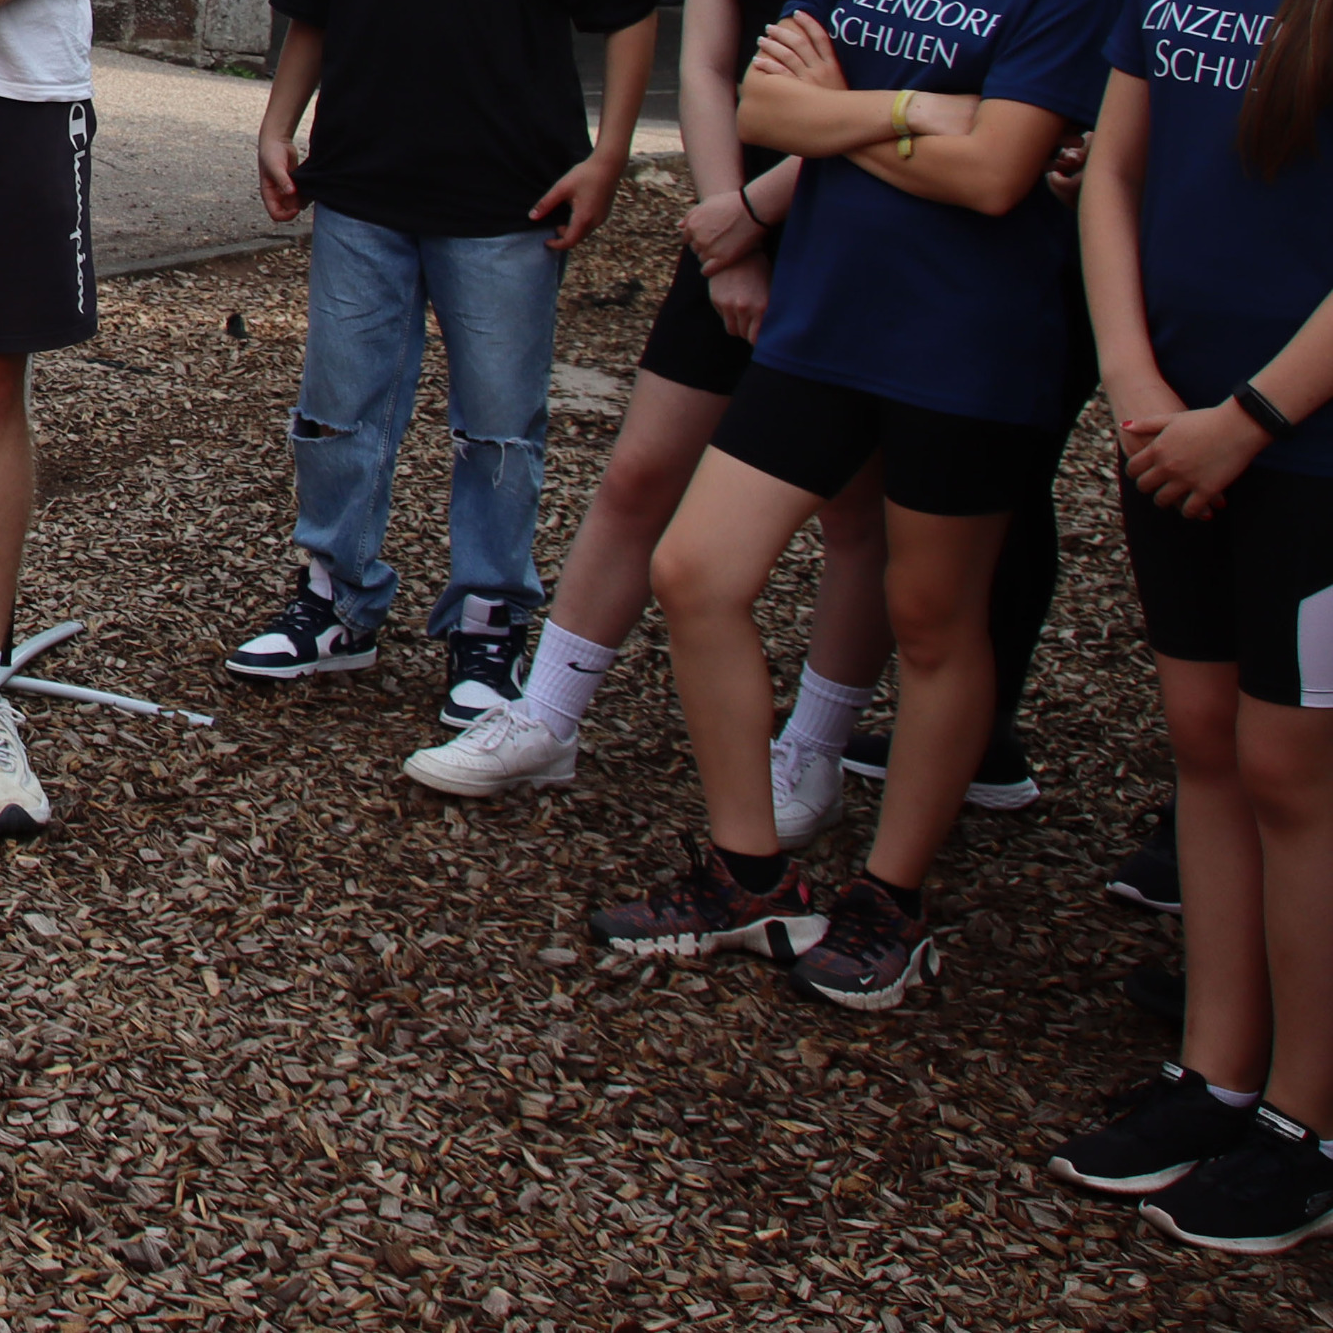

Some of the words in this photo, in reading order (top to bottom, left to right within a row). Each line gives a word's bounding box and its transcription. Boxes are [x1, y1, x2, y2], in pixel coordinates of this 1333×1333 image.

[829, 7, 959, 69] SCHULEN
[1154, 39, 1258, 91] SCHU
[69, 102, 87, 314] Champion
